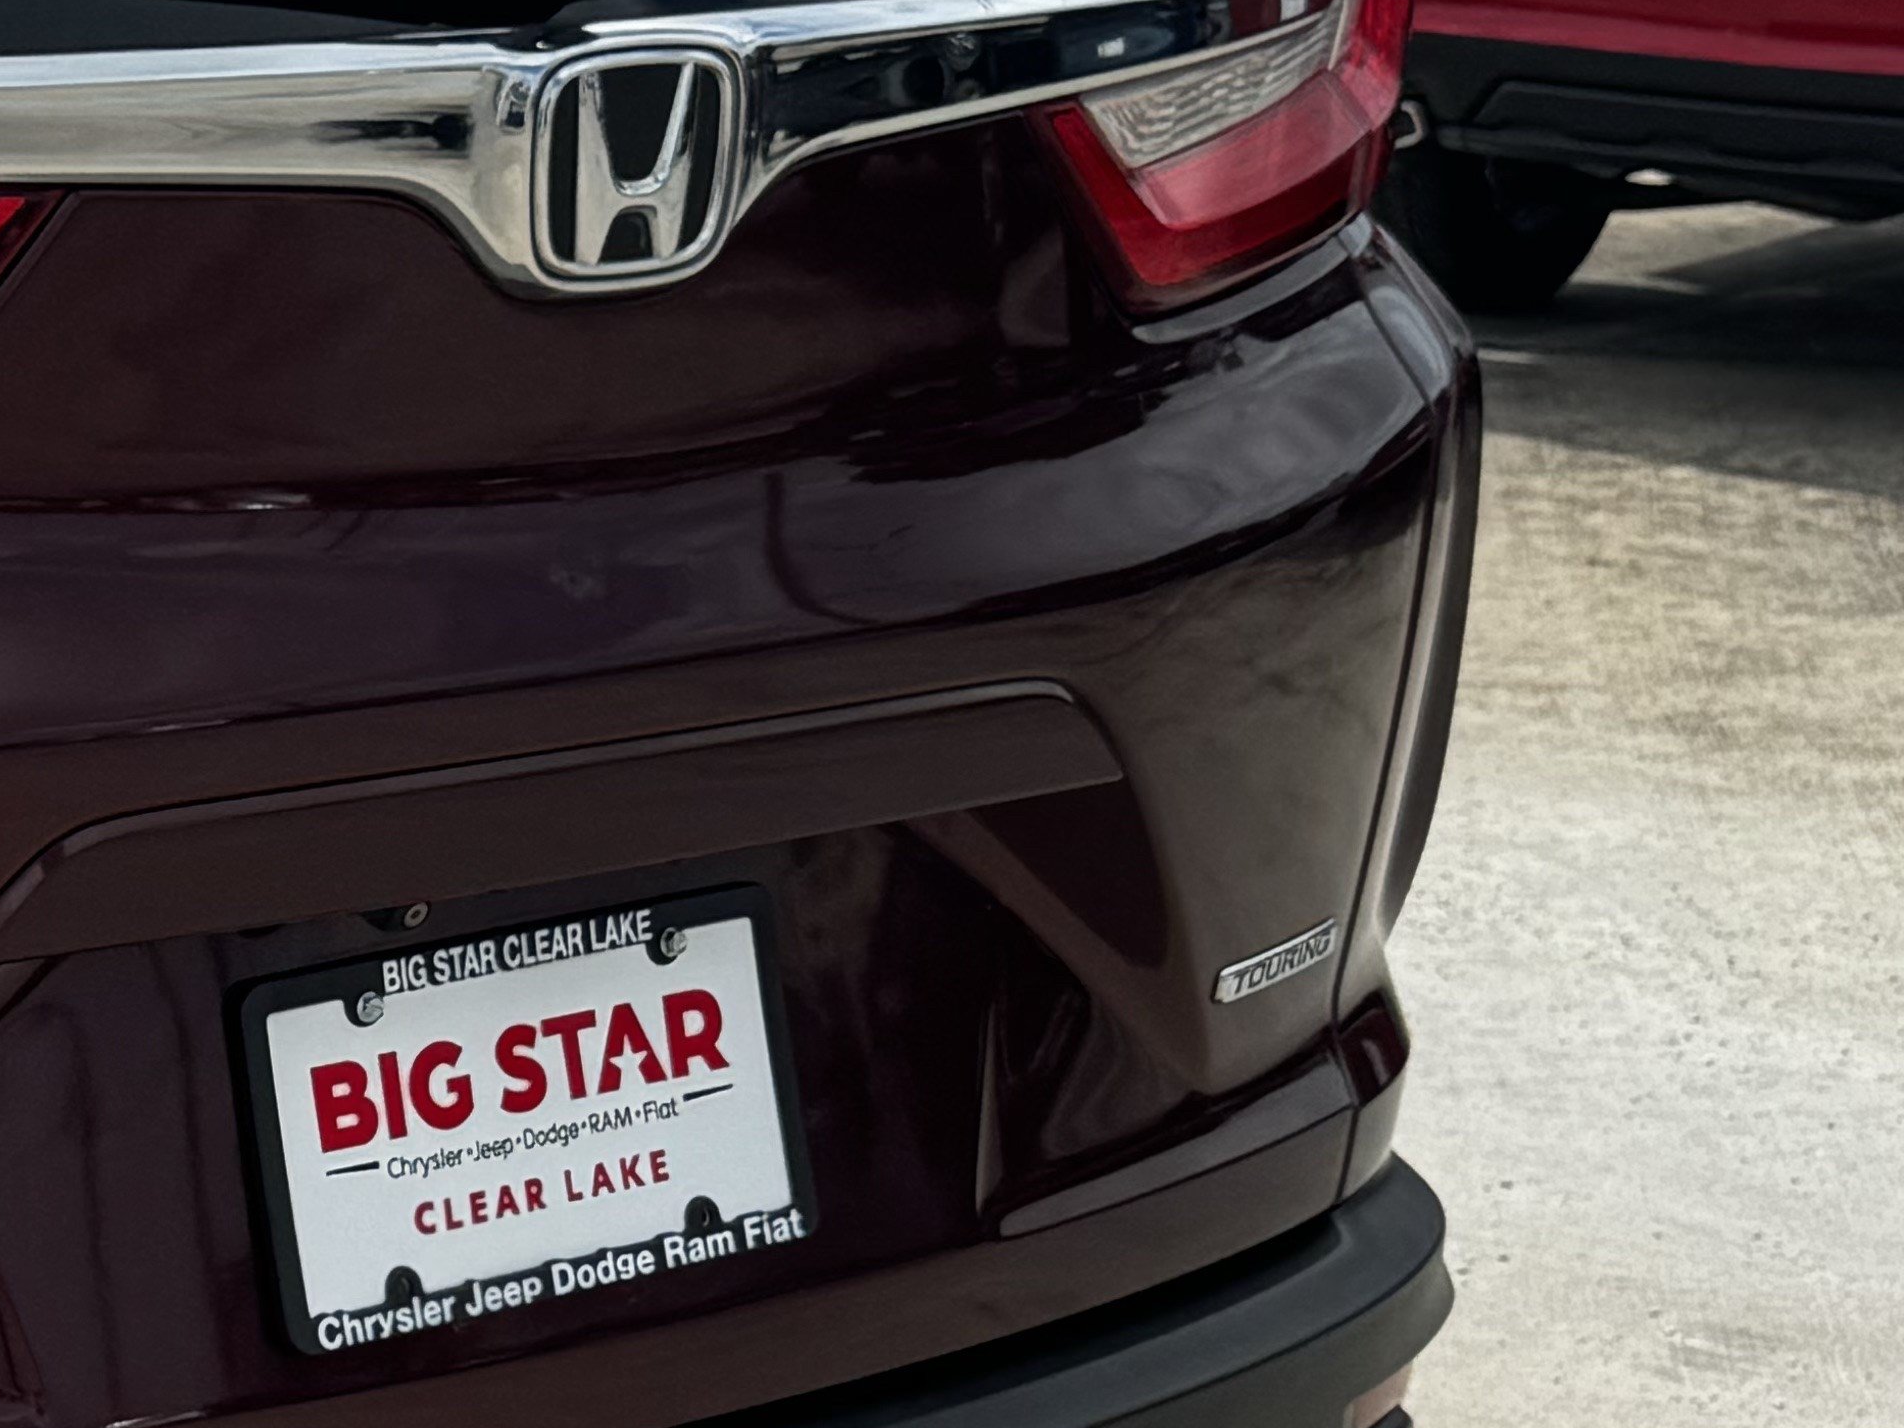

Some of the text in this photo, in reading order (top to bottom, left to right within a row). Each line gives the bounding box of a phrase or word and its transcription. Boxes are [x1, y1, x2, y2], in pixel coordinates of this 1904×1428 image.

[382, 908, 653, 994] BIG STAR CLEAR LAKE
[1233, 932, 1331, 995] TOURING
[309, 988, 731, 1154] BIG STAR
[413, 1149, 671, 1235] CLEAR LAKE
[317, 1207, 808, 1352] Chrysler Jeep Dodge Ram Fiat
